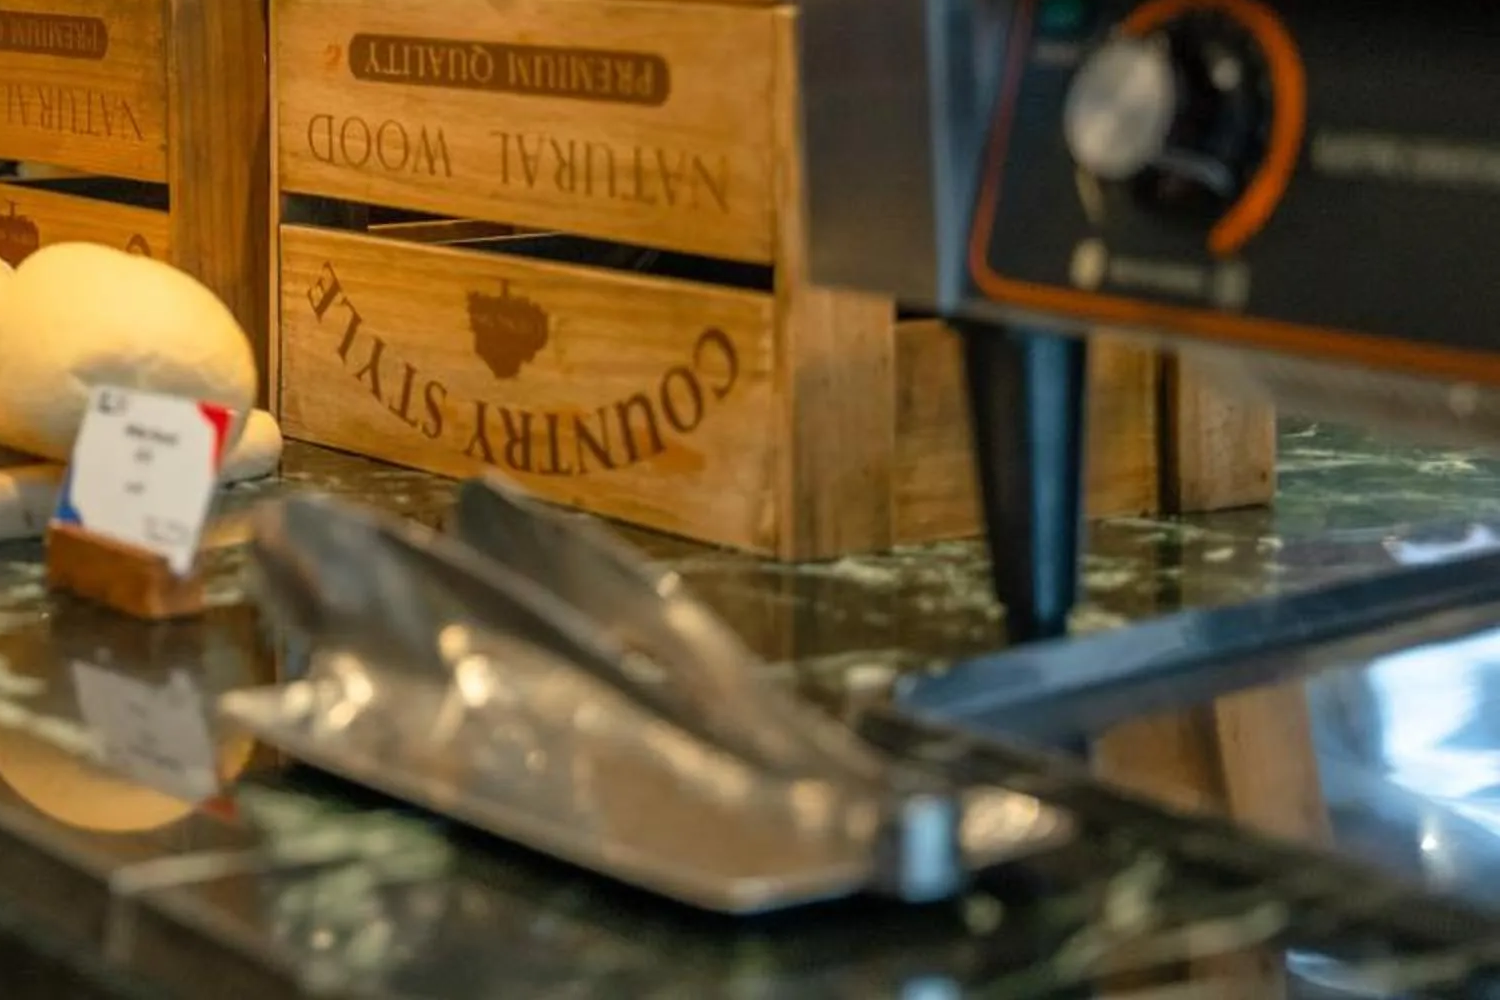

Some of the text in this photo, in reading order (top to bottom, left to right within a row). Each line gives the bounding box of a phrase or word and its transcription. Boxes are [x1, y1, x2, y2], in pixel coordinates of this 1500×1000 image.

[363, 40, 657, 97] PREMIUM QUALITY
[4, 83, 145, 142] NATURAL
[307, 113, 731, 215] NATURAL WOOD
[306, 260, 741, 477] COUNTRY STYLE
